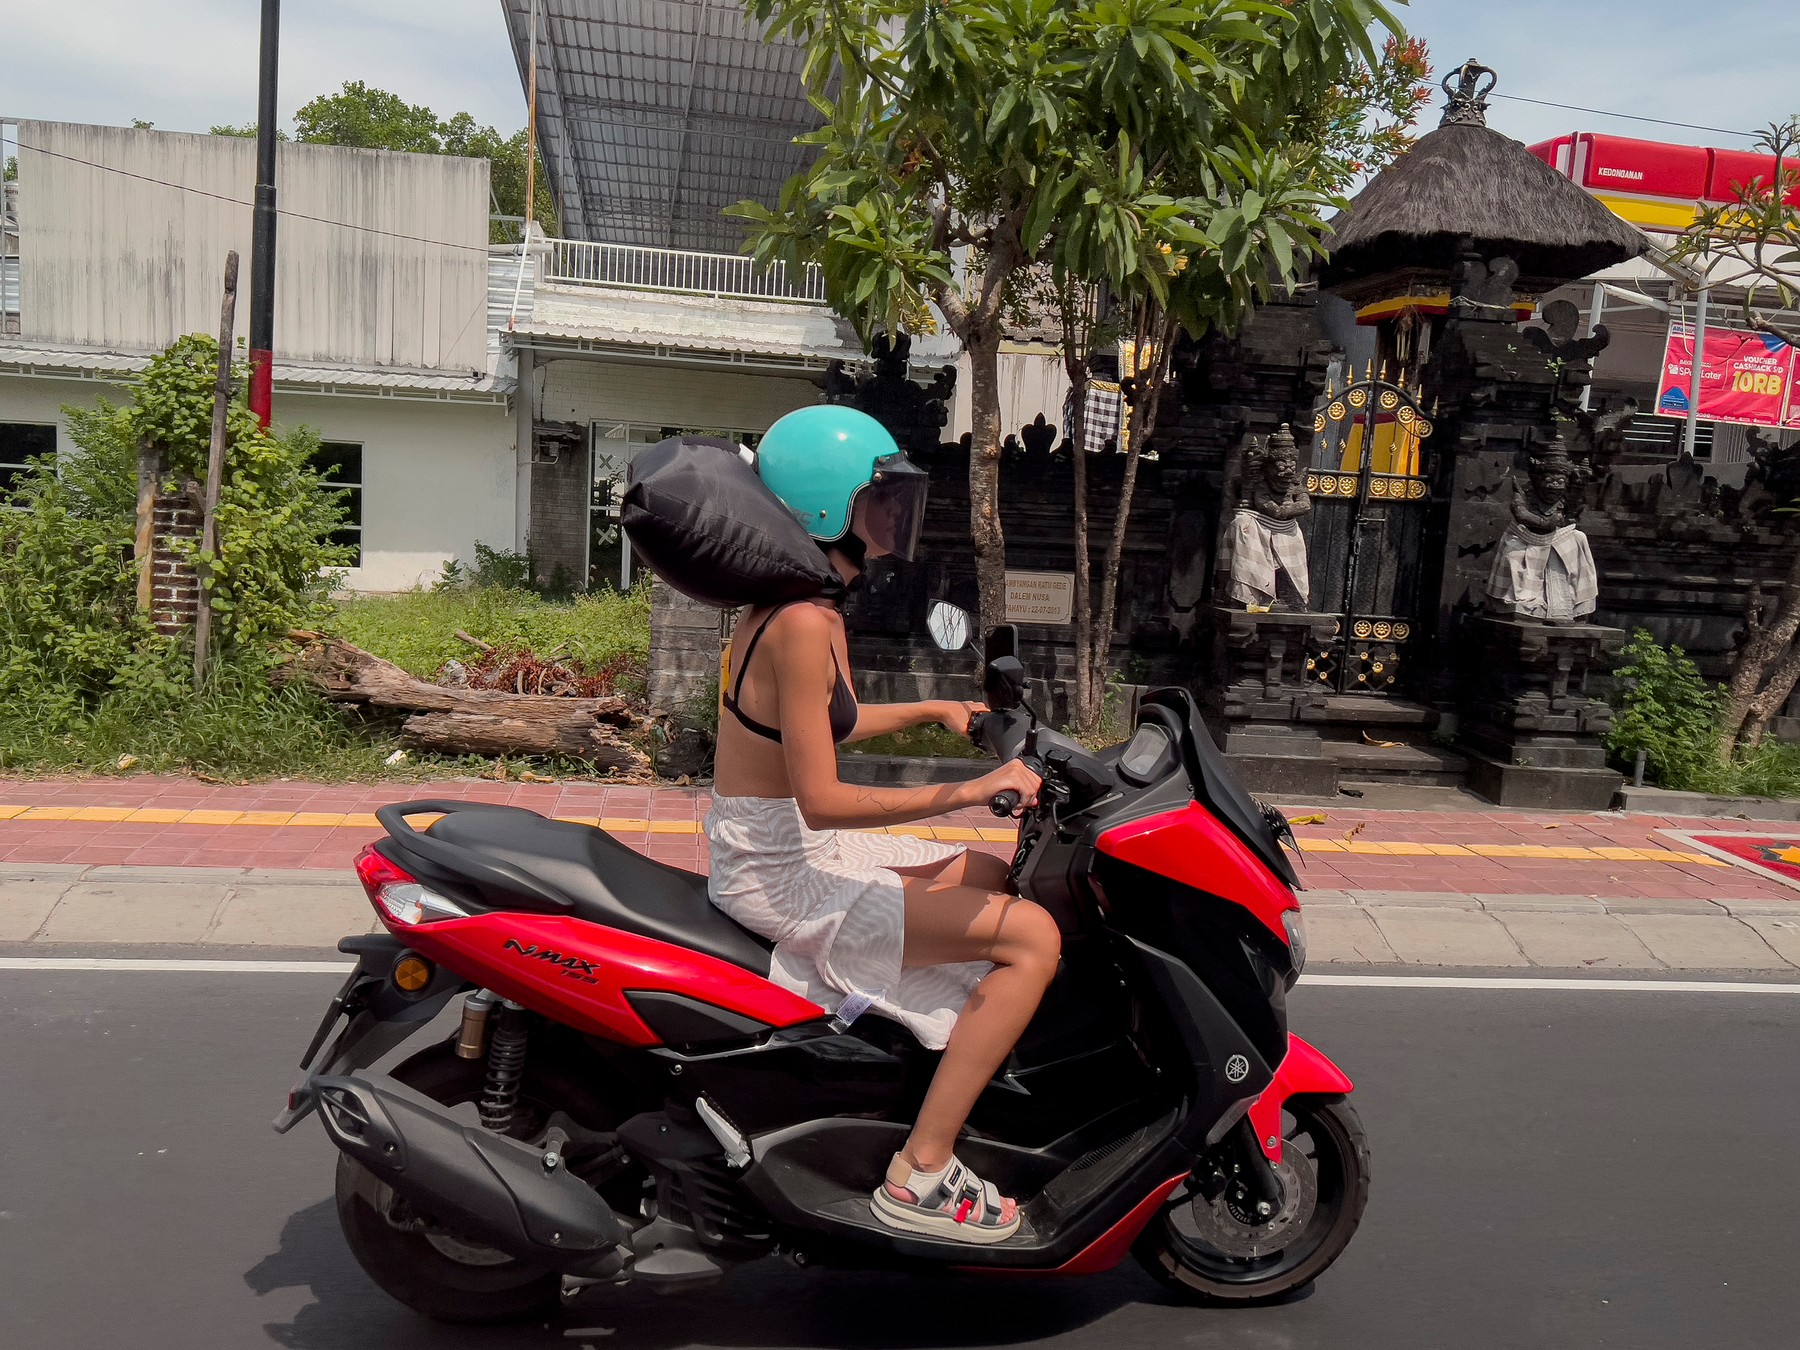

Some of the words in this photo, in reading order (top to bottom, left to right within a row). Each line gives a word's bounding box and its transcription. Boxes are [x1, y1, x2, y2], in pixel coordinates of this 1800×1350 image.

[1743, 356, 1778, 365] VOUCHER
[1733, 362, 1772, 372] CASHBACK
[1731, 371, 1782, 396] 10RB
[1037, 581, 1052, 589] RATU
[1052, 581, 1067, 590] GEDE
[1010, 592, 1031, 600] DALEM
[1031, 593, 1050, 601] NUSA
[503, 938, 601, 975] NMAX
